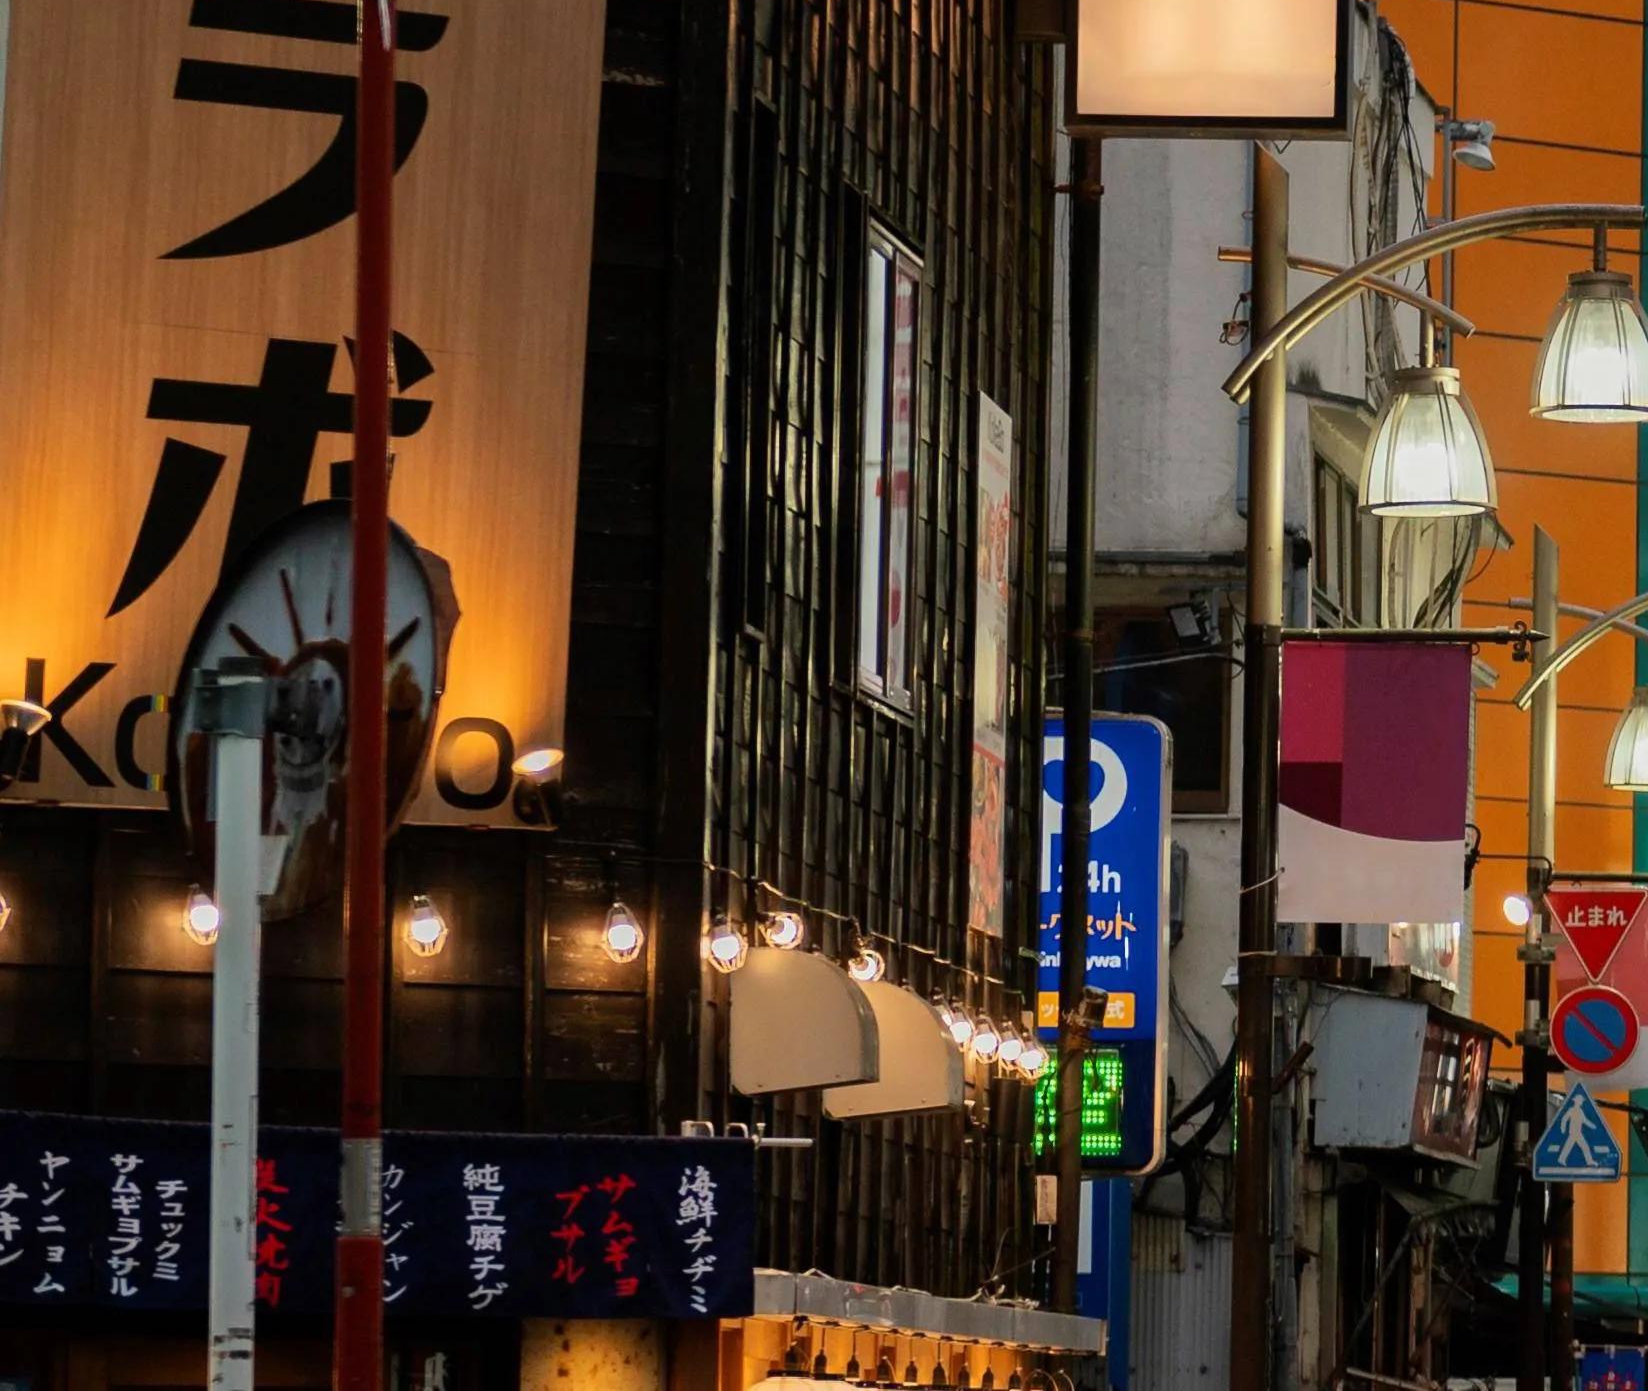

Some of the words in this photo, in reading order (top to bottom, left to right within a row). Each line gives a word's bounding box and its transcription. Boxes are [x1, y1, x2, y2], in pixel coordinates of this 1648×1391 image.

[1565, 905, 1629, 928] 止まれ
[33, 1151, 70, 1294] ヤンニョム
[107, 1153, 144, 1297] サムギョプサル
[152, 1179, 188, 1281] チュックミ
[381, 1163, 414, 1303] カンジャン
[462, 1162, 509, 1310] 純豆腐チゲ
[596, 1173, 640, 1297] サムギョ
[675, 1165, 719, 1313] 海鮮チヂミ
